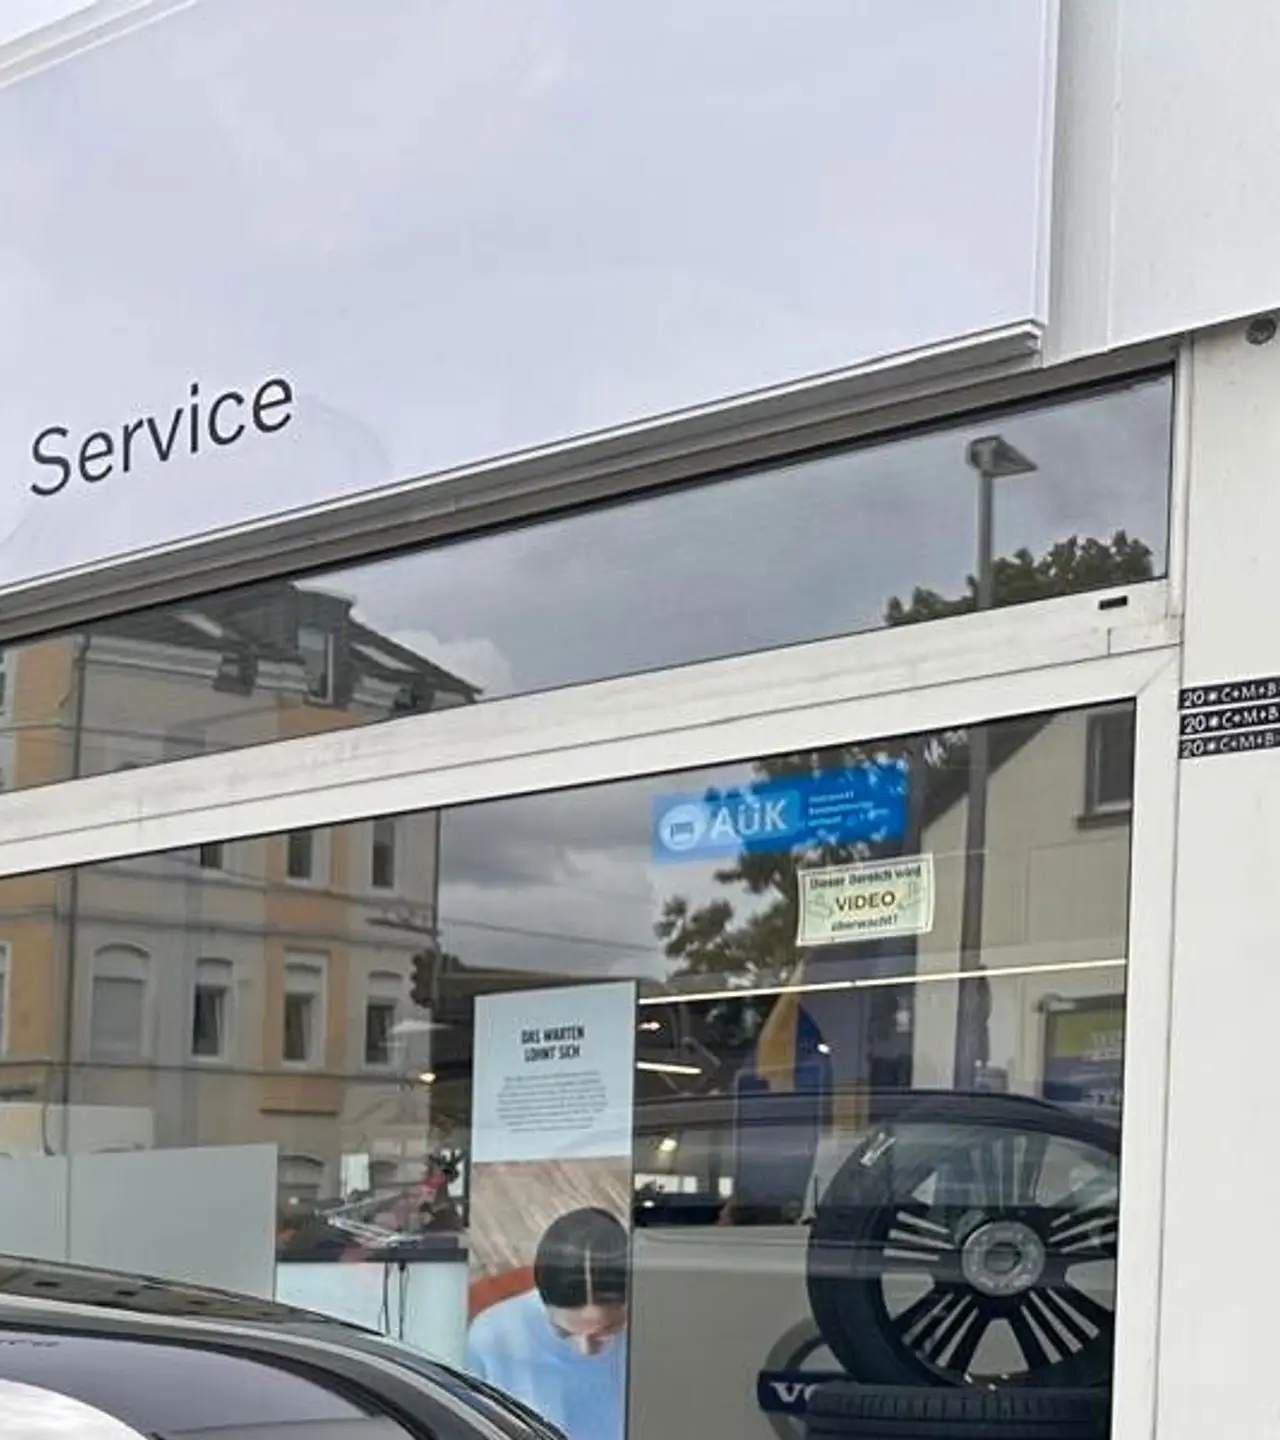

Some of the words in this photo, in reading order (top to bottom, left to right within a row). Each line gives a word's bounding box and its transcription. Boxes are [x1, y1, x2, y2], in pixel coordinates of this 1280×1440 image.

[30, 377, 293, 496] Service
[896, 864, 921, 878] wird
[836, 890, 896, 912] VIDEO
[521, 1029, 541, 1045] DAS
[544, 1026, 585, 1042] WARTEN
[525, 1046, 555, 1062] LOHNT
[559, 1045, 581, 1060] SICH
